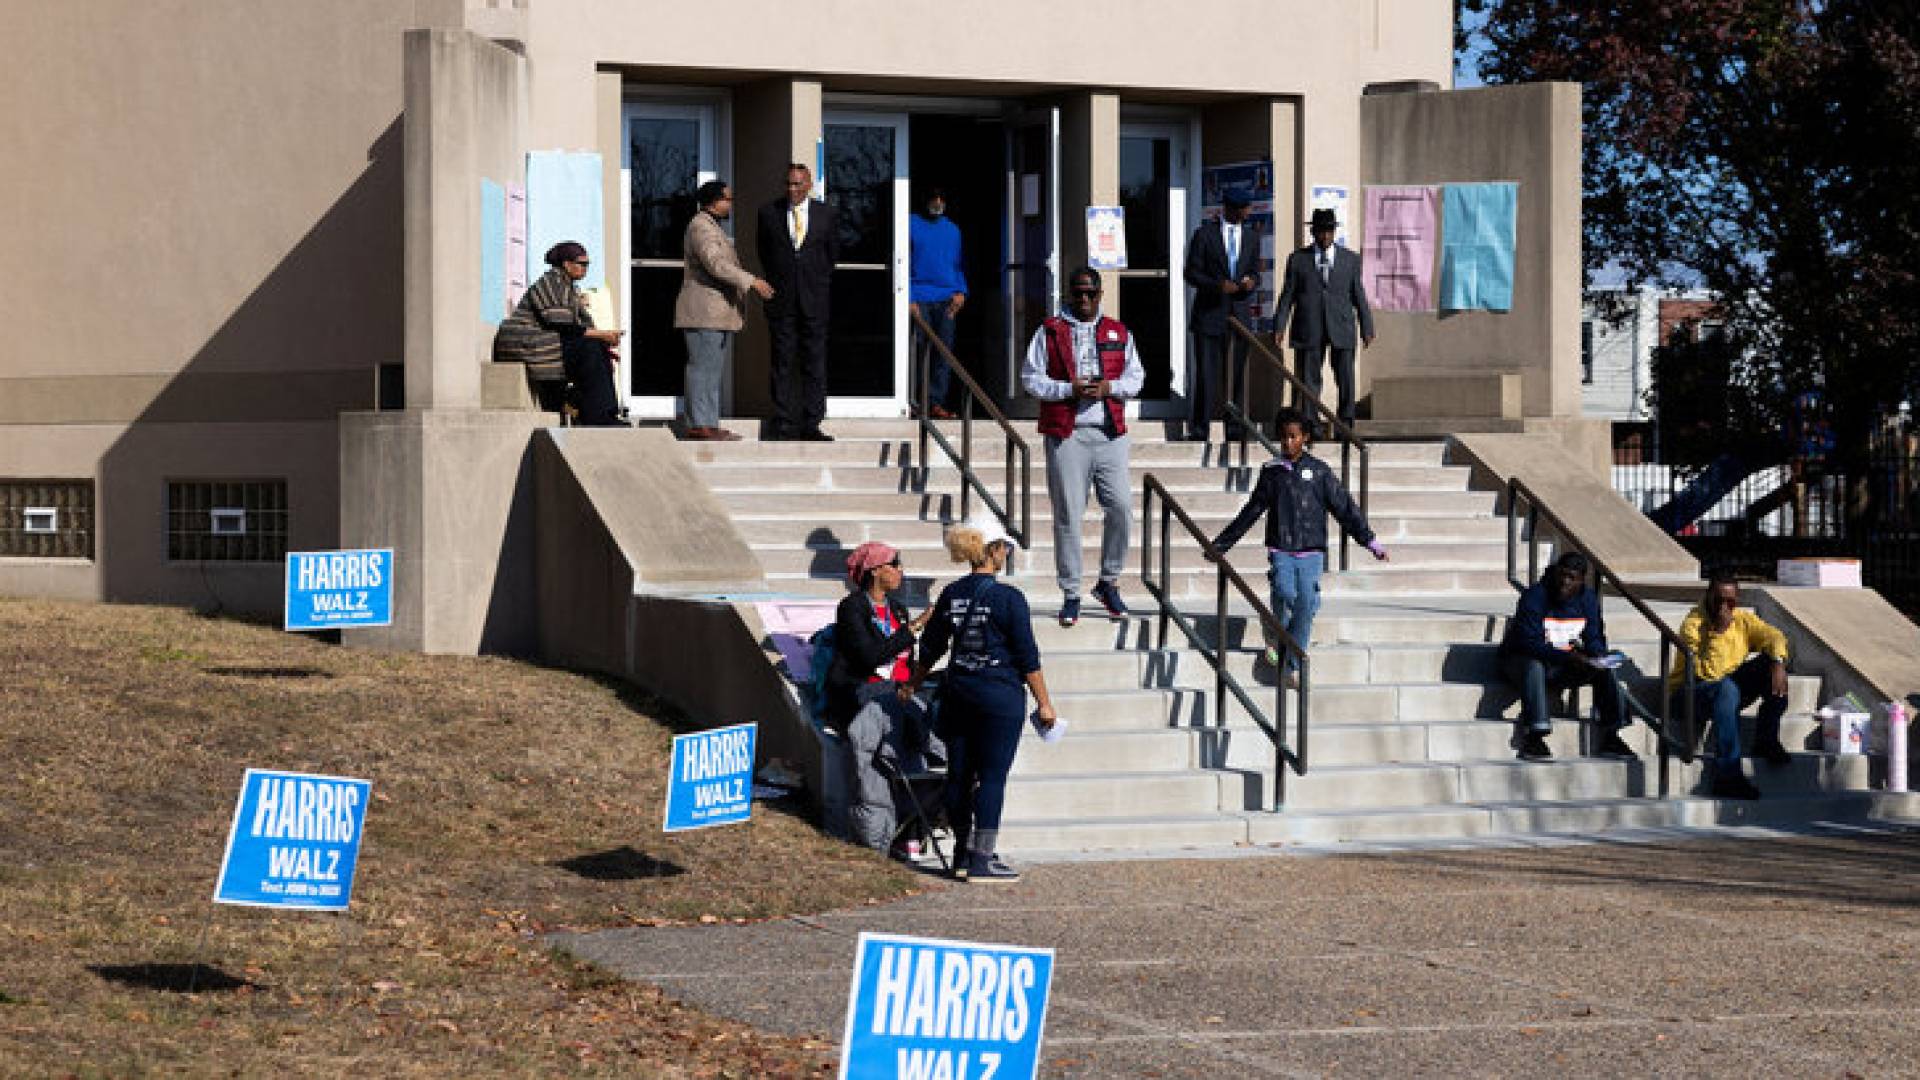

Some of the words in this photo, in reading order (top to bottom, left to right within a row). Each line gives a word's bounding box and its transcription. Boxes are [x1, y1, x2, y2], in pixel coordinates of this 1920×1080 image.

[299, 554, 383, 590] HARRIS
[312, 592, 368, 612] WALZ
[682, 730, 750, 783] HARRIS
[251, 778, 359, 843] HARRIS
[694, 778, 746, 808] WALZ
[268, 845, 341, 881] WALZ
[871, 947, 1035, 1044] HARRIS
